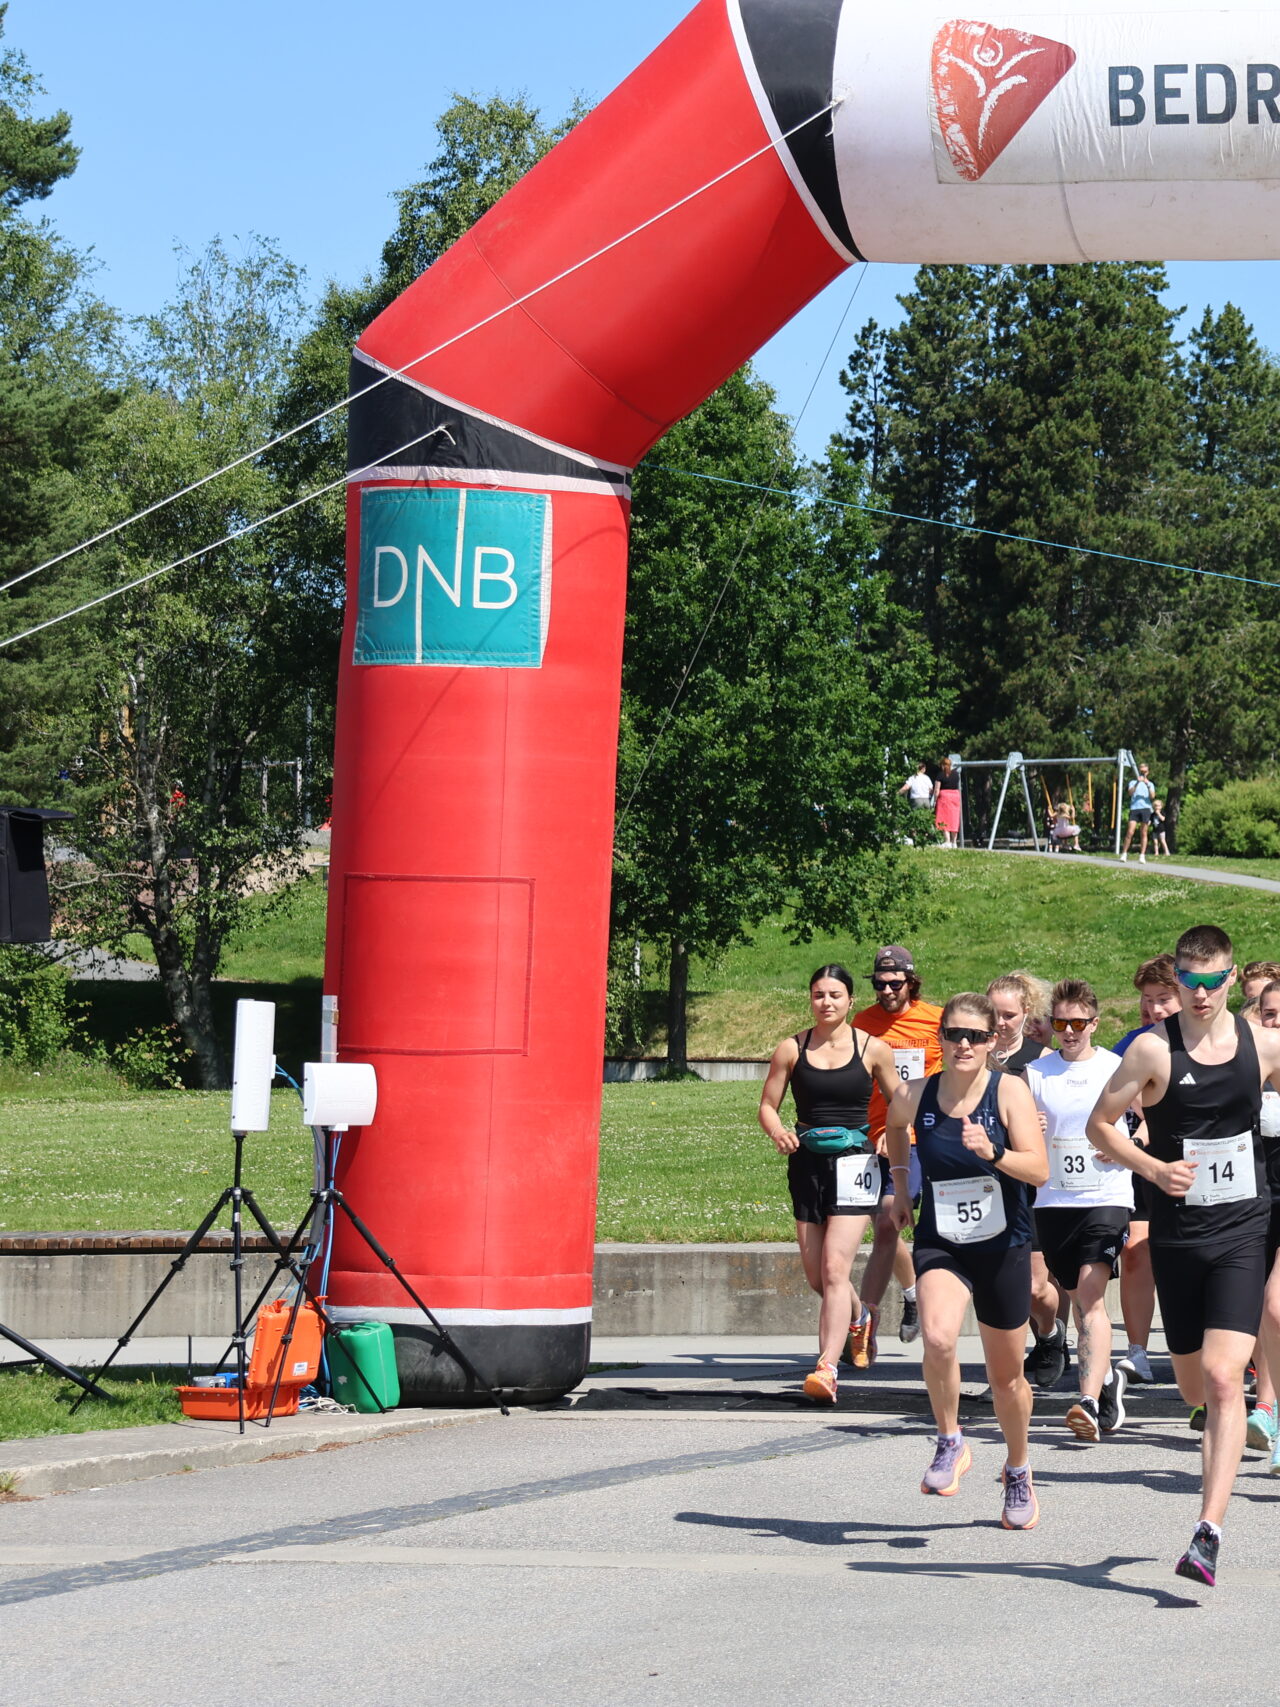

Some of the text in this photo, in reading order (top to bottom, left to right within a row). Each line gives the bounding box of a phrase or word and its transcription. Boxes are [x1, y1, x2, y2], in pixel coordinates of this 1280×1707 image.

[373, 488, 518, 664] DNB
[1064, 1155, 1085, 1174] 33
[1208, 1160, 1235, 1184] 14
[854, 1171, 872, 1190] 40
[957, 1200, 983, 1223] 55
